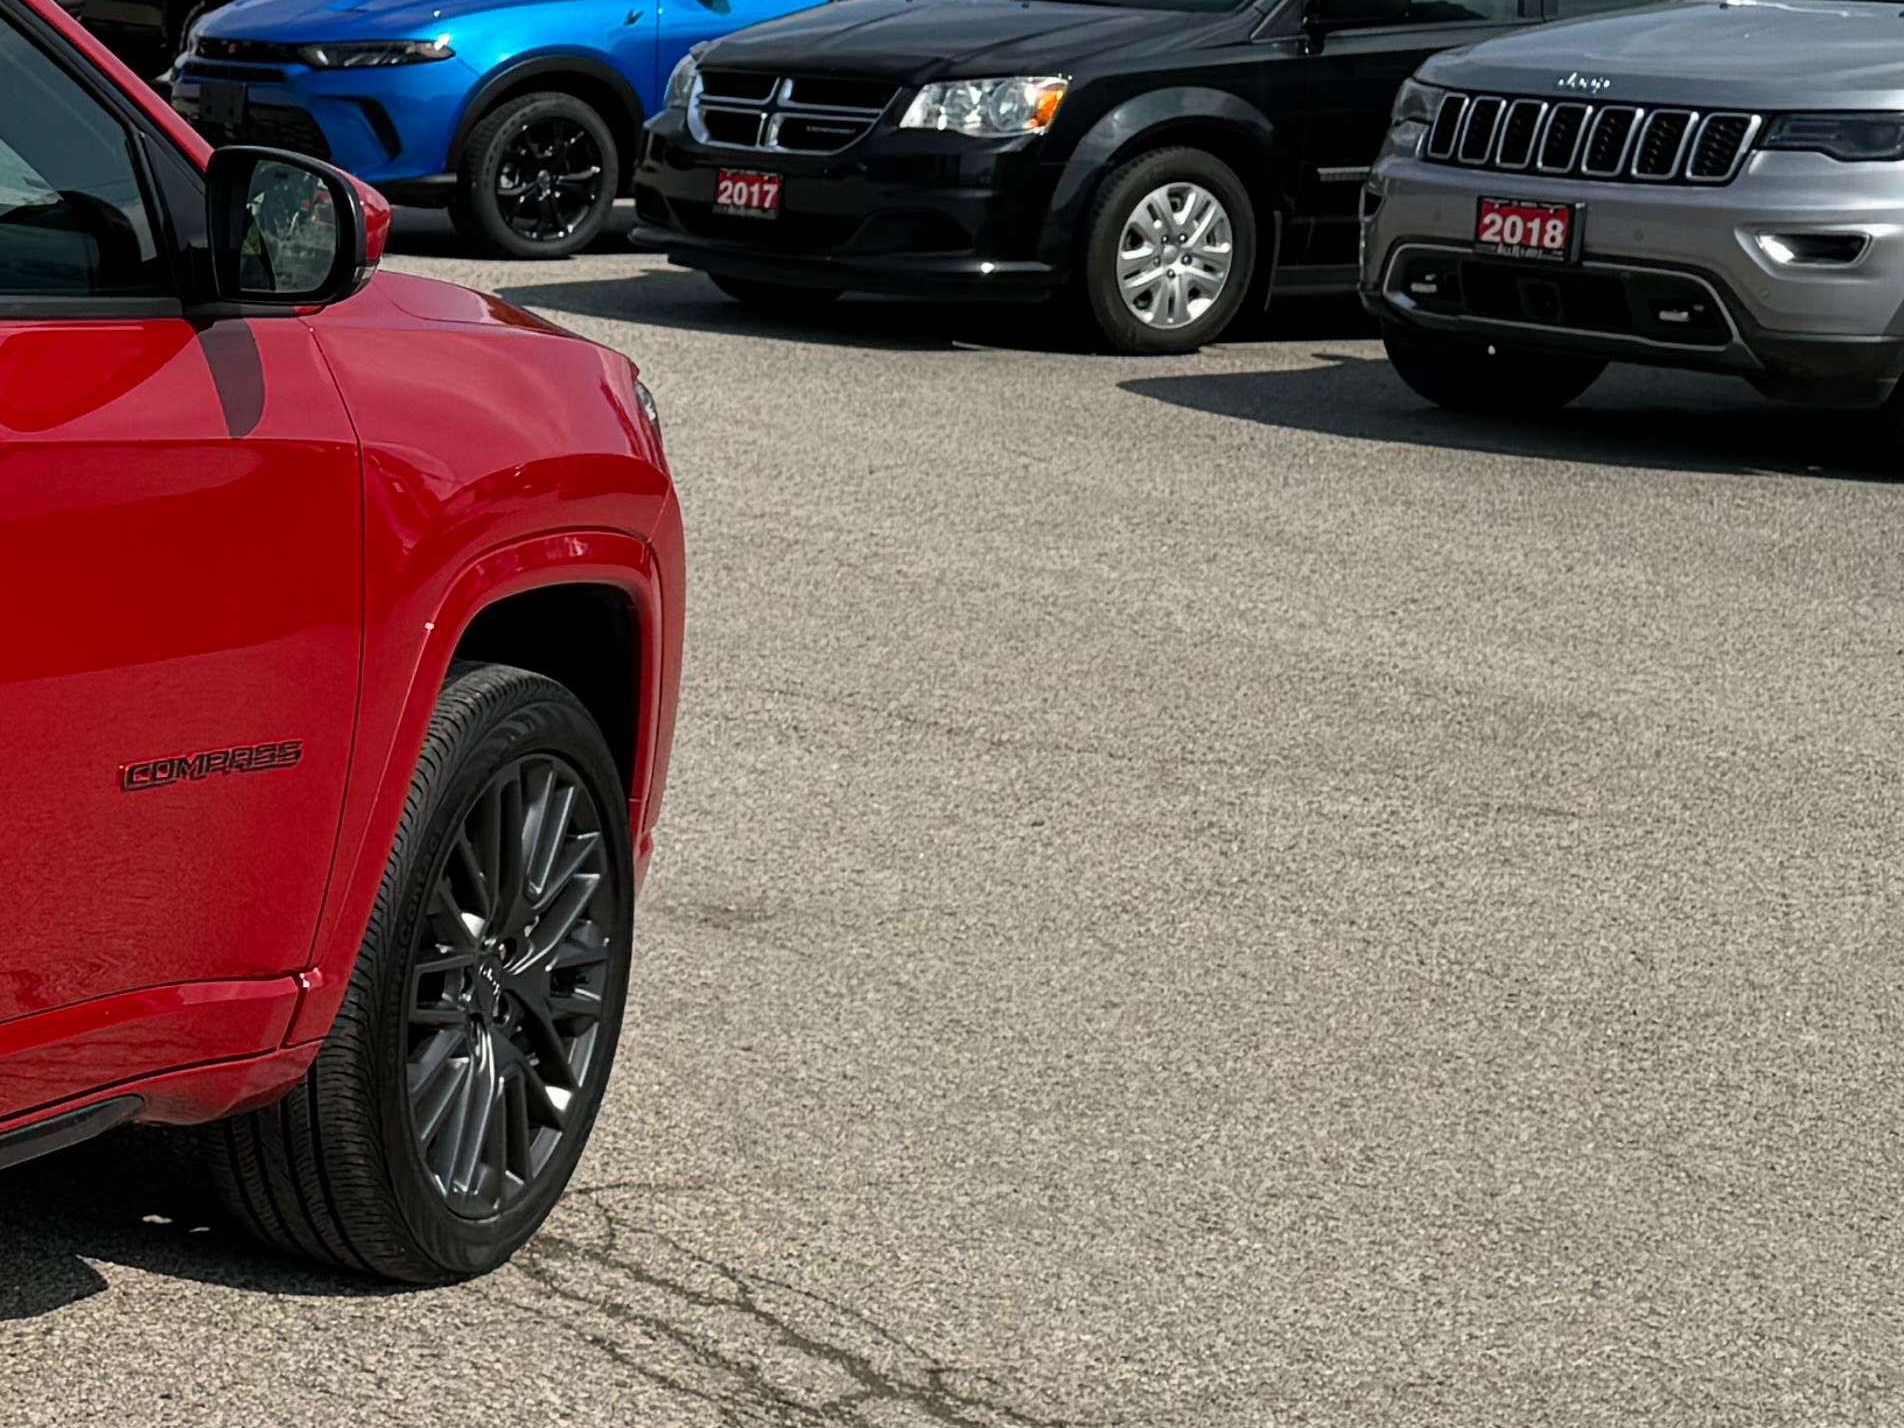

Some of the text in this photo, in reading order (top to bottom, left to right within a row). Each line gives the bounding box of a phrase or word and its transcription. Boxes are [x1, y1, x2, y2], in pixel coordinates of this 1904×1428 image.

[717, 179, 779, 209] 2017
[1479, 212, 1565, 249] 2018
[121, 739, 304, 792] COMPASS
